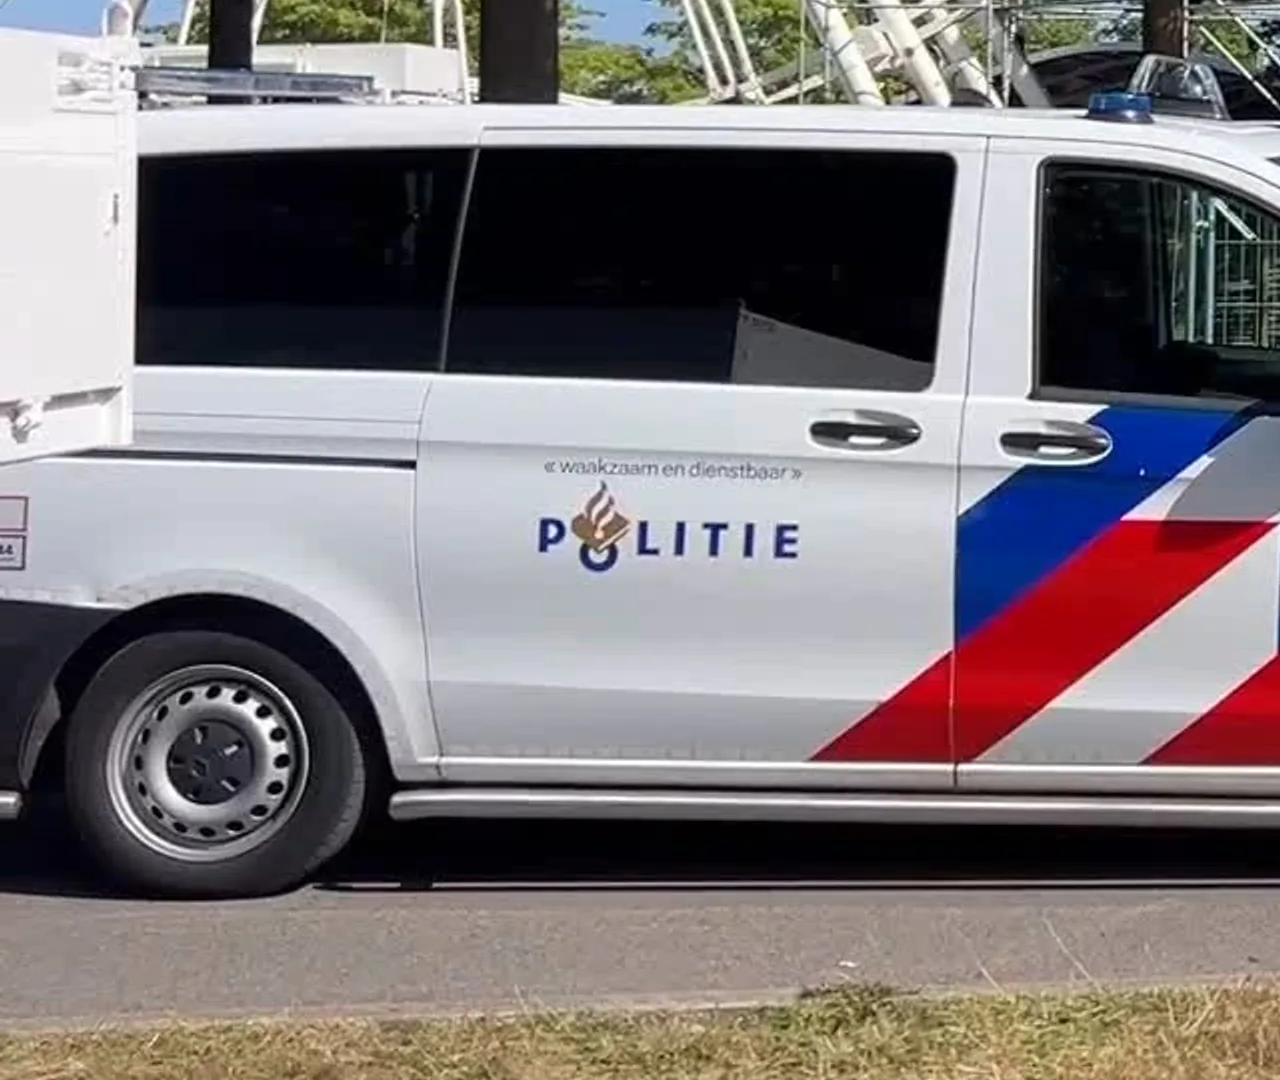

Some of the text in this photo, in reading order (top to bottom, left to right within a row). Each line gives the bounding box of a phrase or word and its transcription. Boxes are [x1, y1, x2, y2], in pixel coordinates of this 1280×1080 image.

[560, 458, 659, 478] waakzaam
[662, 463, 687, 478] en
[688, 461, 787, 480] dienstbaar
[537, 516, 800, 572] POLITIE
